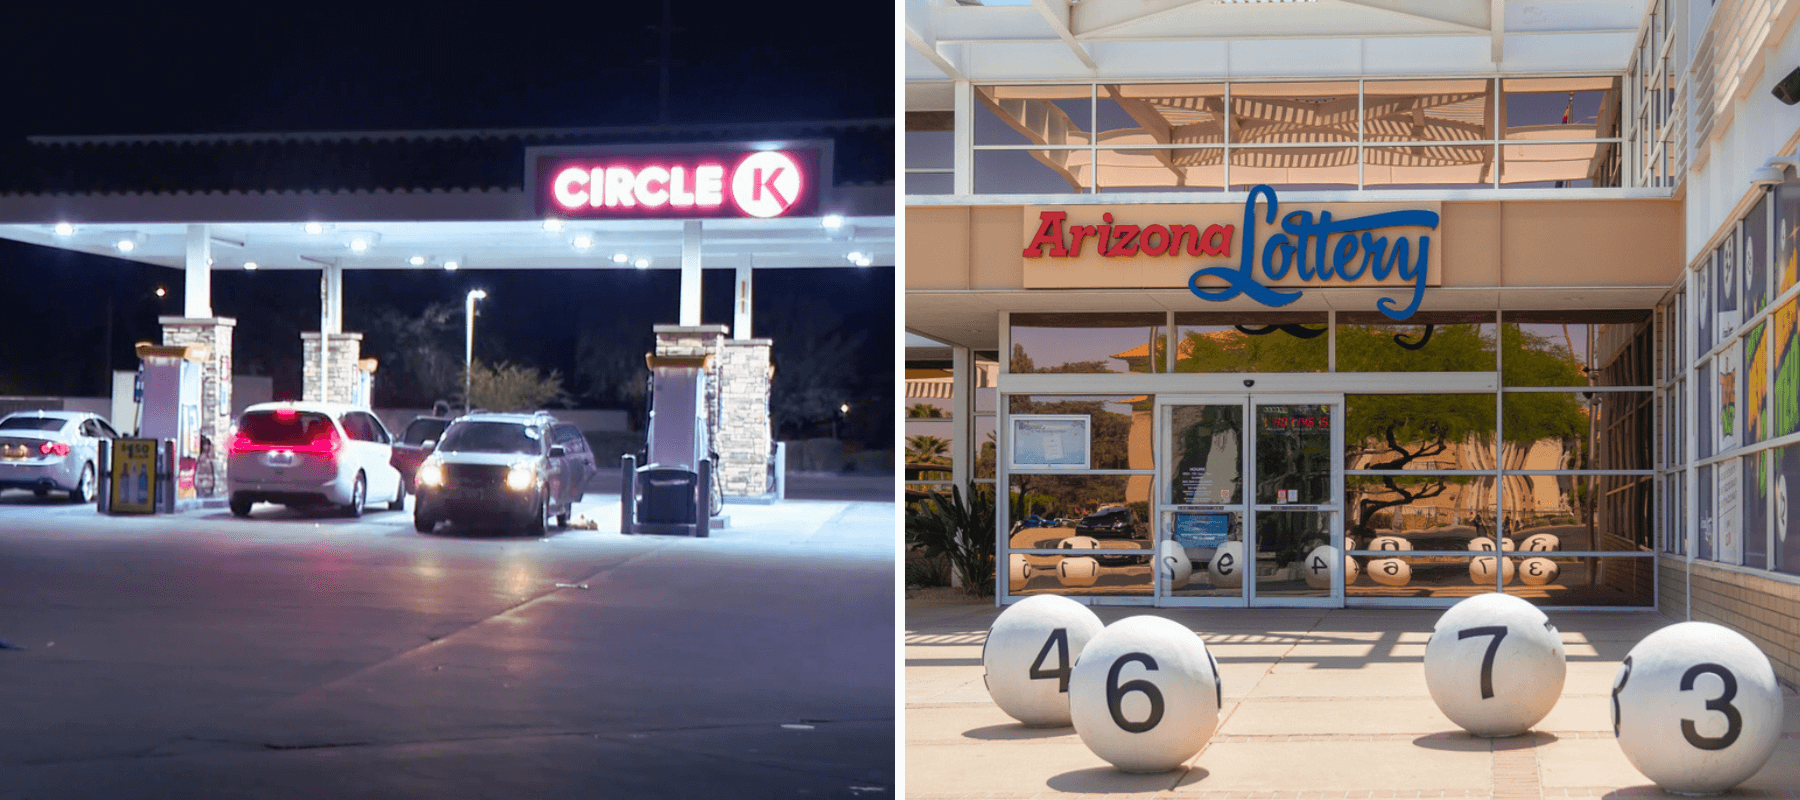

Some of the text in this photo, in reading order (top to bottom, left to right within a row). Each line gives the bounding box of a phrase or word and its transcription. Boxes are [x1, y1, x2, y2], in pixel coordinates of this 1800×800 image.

[554, 165, 790, 212] CIRCLE K
[1022, 184, 1440, 320] Arizona Lottery
[1029, 628, 1072, 693] 4
[1106, 652, 1165, 733] 6
[1458, 626, 1508, 700] 7
[1679, 663, 1743, 751] 3
